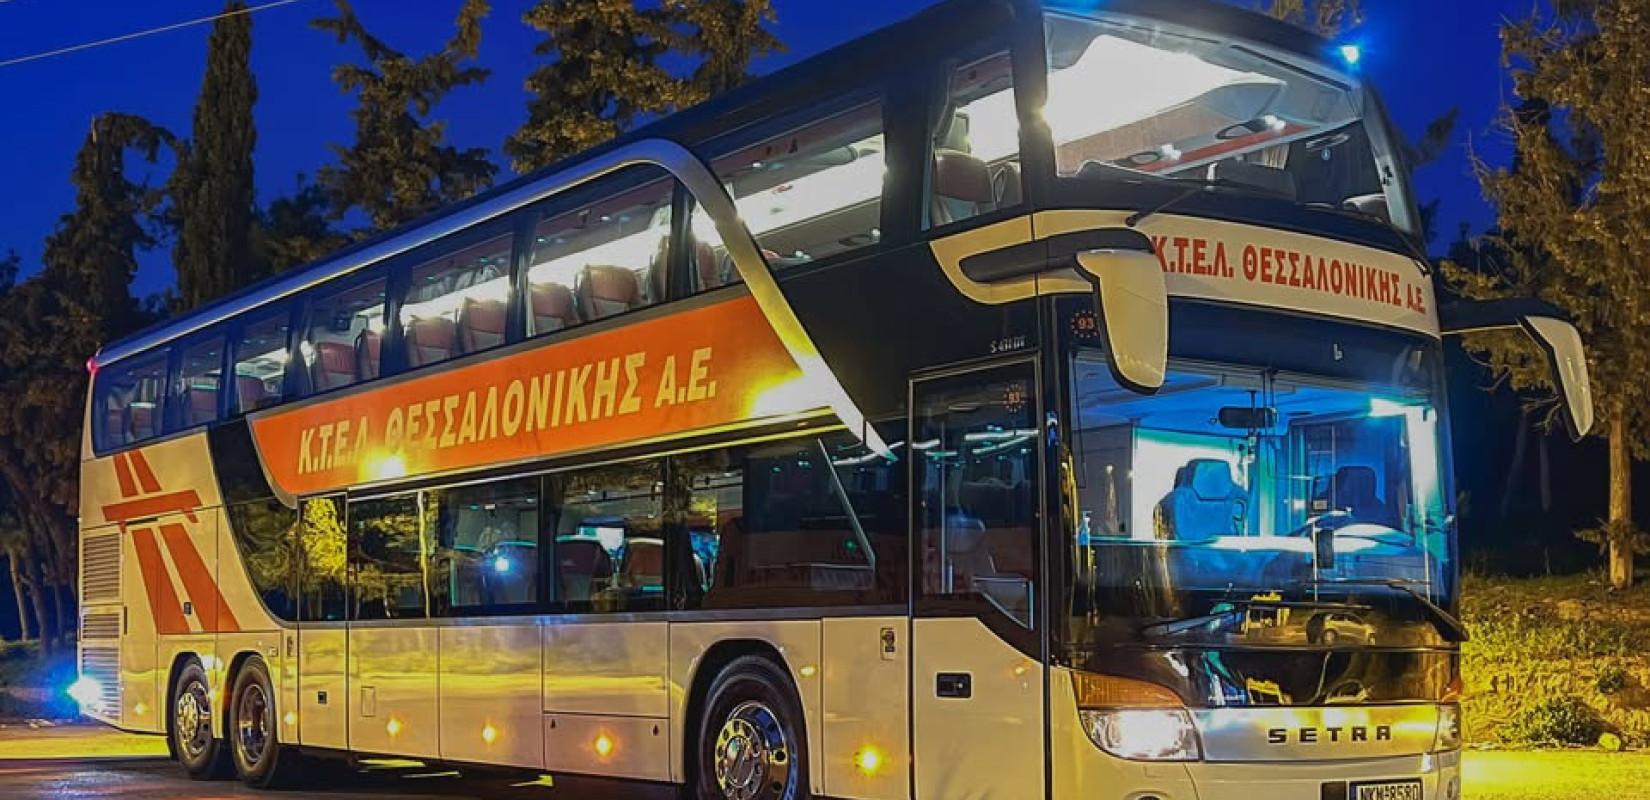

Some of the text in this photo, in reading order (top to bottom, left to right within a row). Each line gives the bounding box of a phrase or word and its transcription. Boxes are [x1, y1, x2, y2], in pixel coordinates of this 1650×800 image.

[1242, 243, 1402, 307] ΘΕΣΣΑΛΟΝΙΚΗΣ
[384, 351, 648, 455] ΘΕΣΣΑΛΟΝΙΚΗΣ
[655, 346, 718, 408] Α.Ε.
[1267, 725, 1392, 744] SETRA
